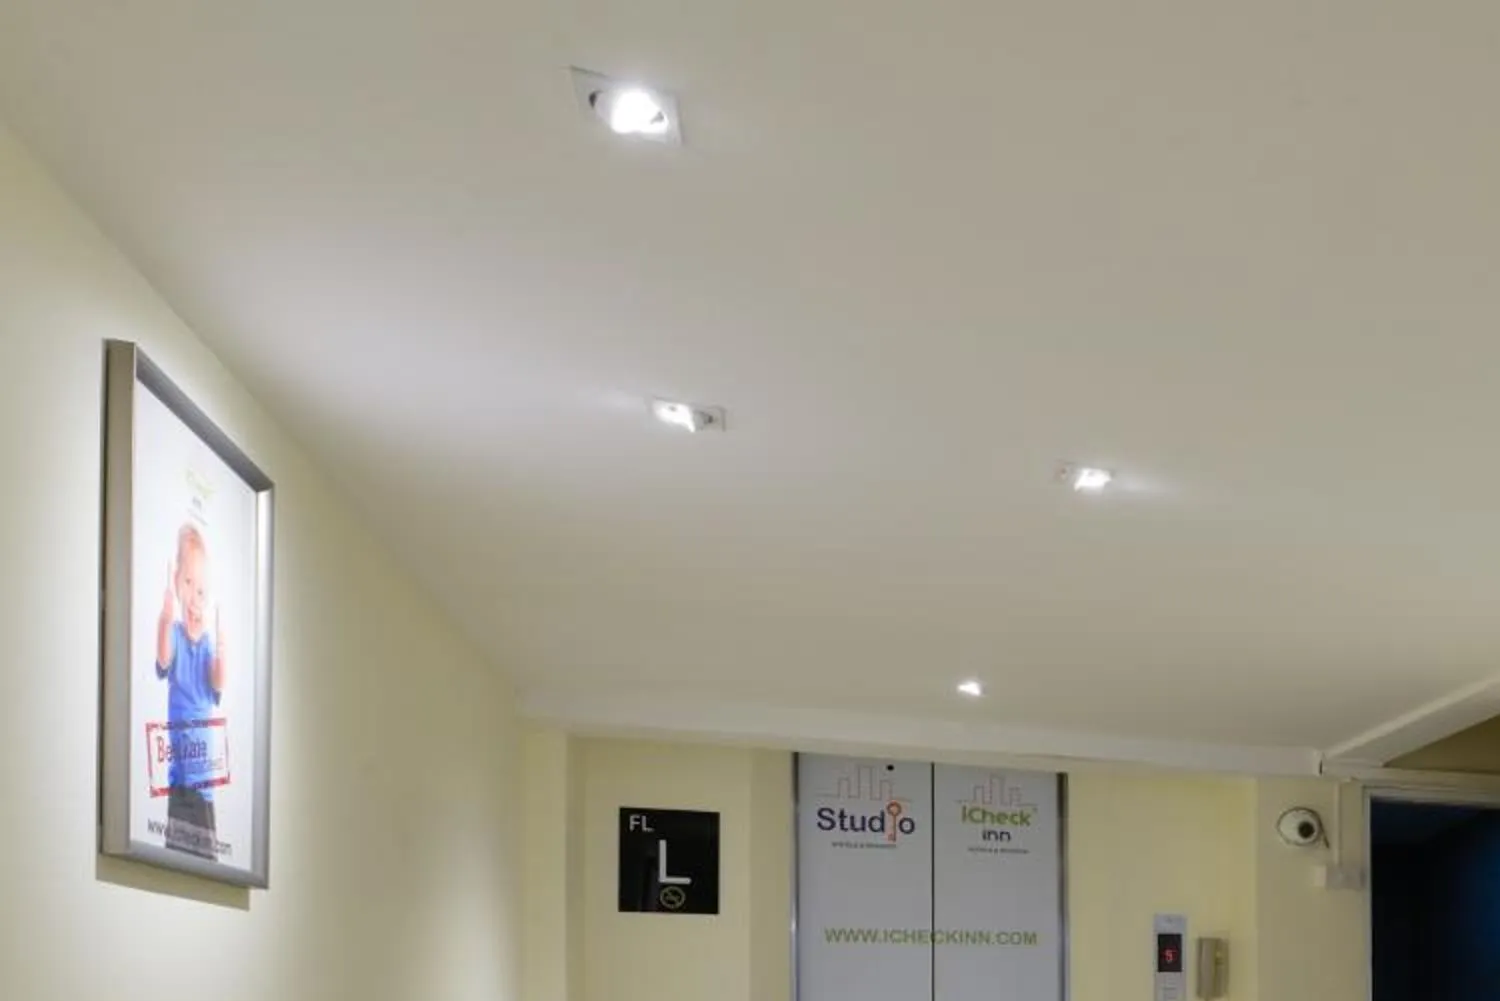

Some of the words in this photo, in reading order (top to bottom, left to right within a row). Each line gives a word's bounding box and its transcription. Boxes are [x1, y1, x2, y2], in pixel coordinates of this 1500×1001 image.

[629, 815, 655, 832] FL
[817, 801, 916, 842] Studio
[982, 829, 1012, 843] inn
[658, 839, 692, 885] L
[824, 927, 1038, 946] WWW.ICHECKINN.COM
